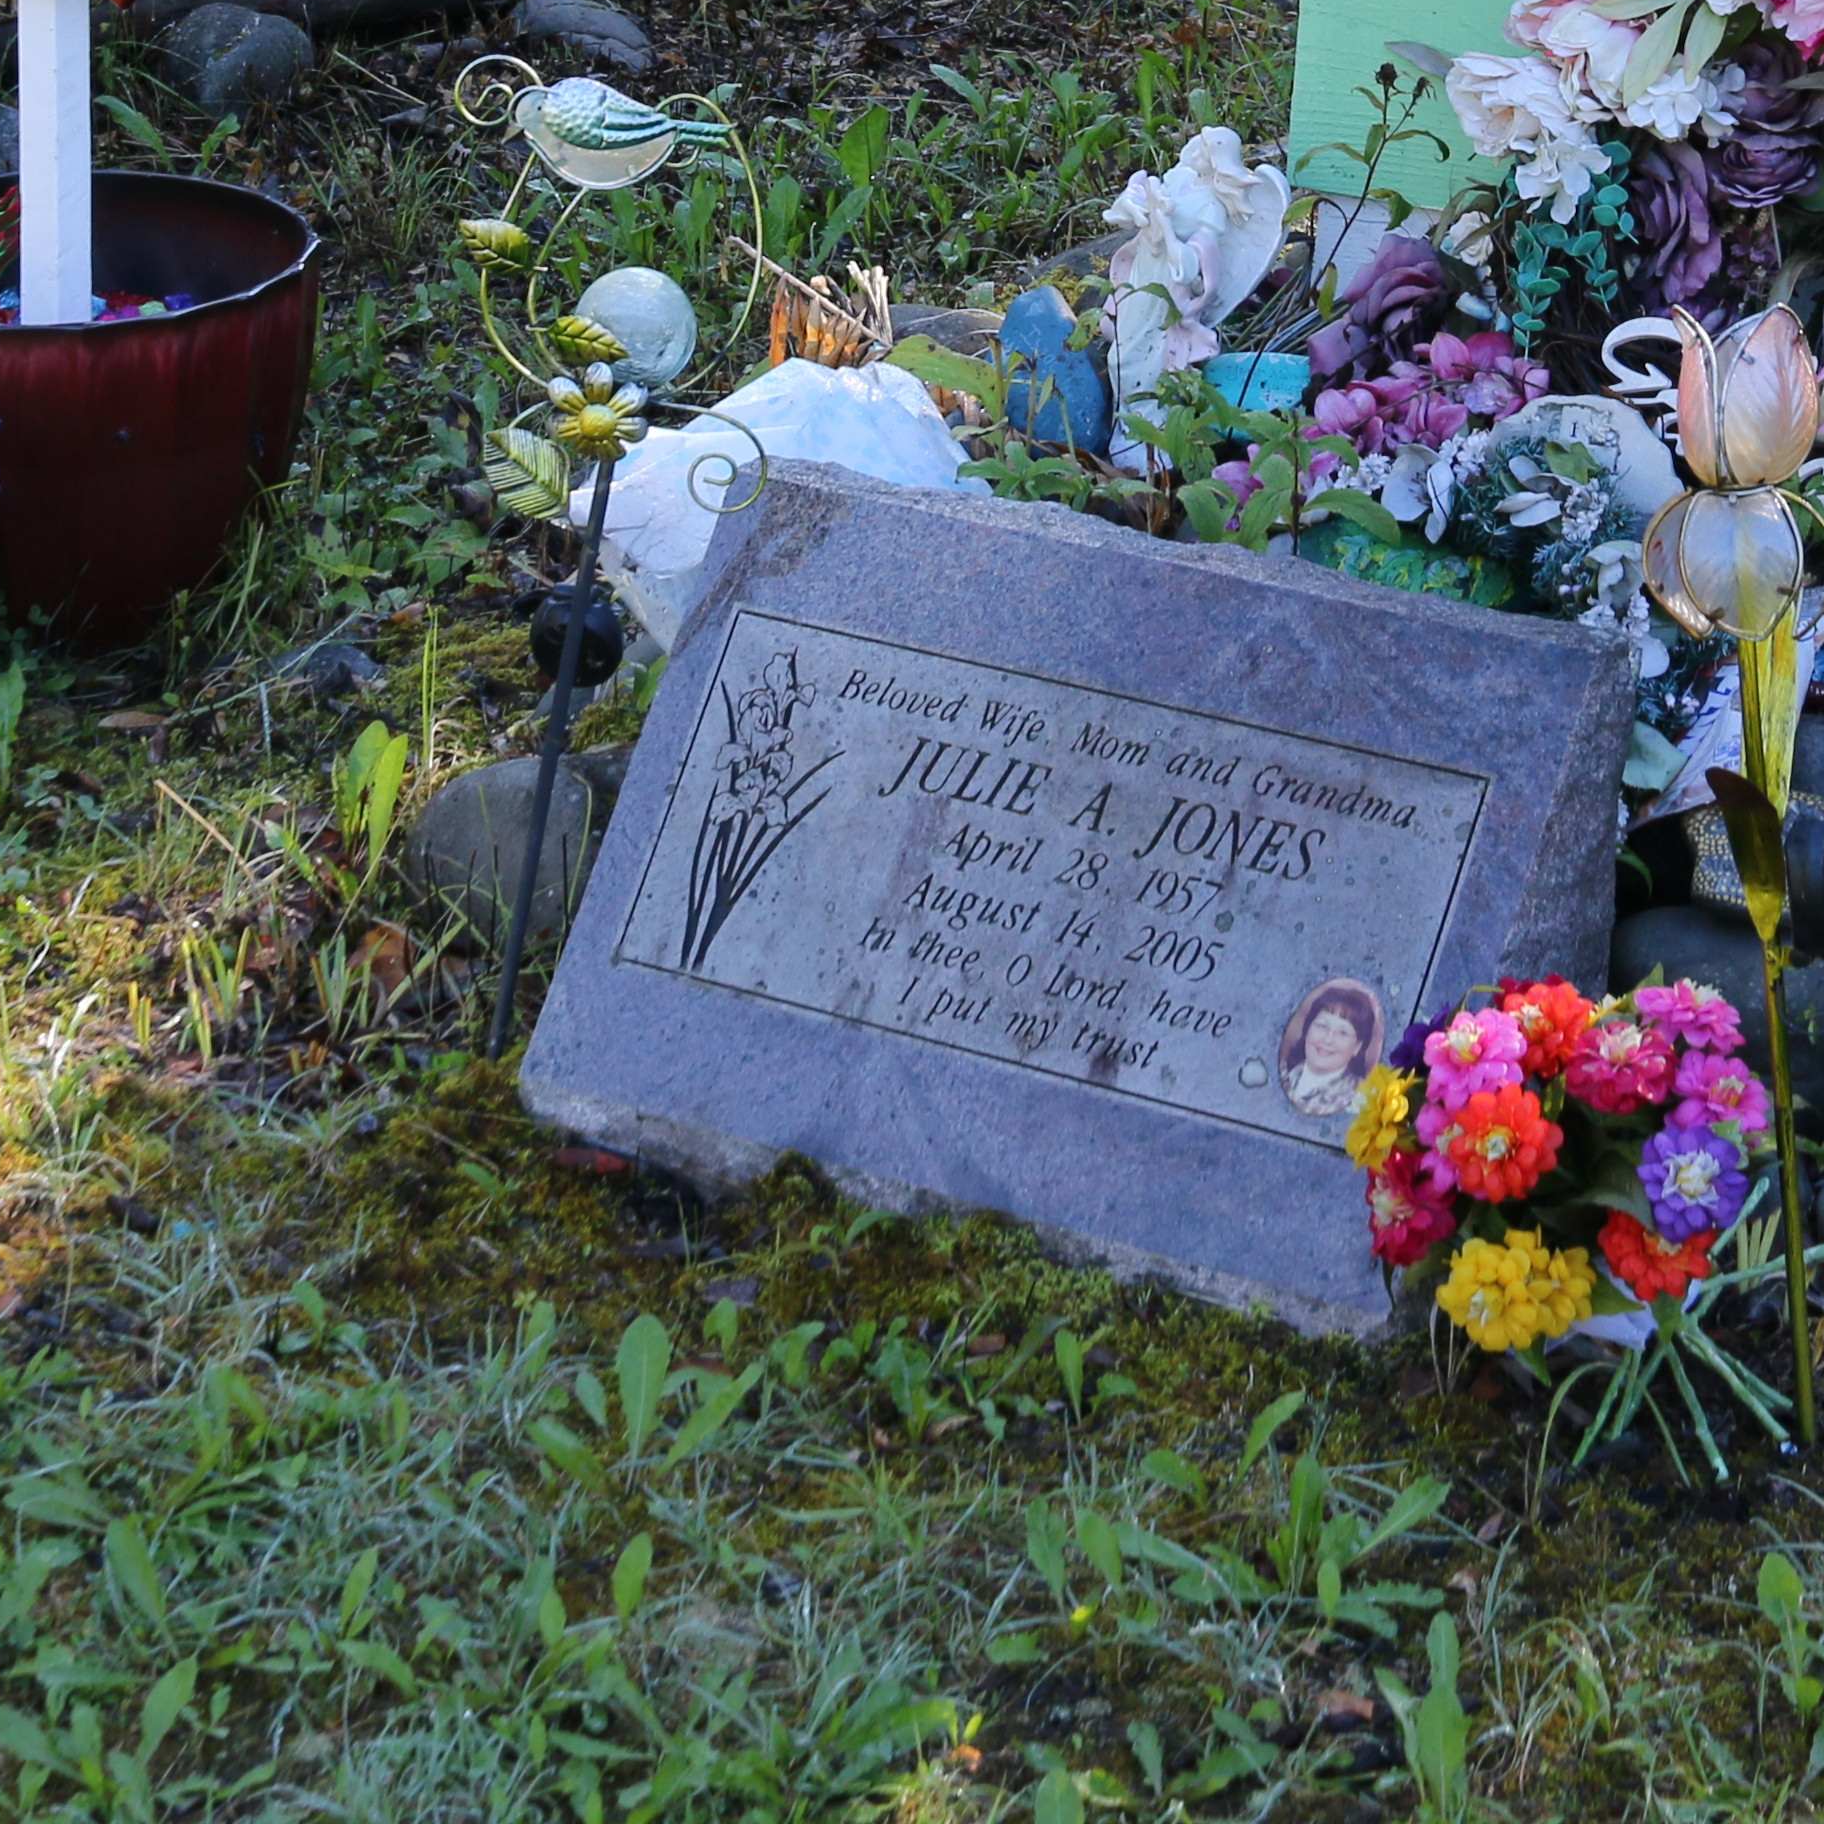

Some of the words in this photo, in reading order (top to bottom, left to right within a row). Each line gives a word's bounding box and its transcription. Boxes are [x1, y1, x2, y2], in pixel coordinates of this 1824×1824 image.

[838, 669, 967, 723] Beloved
[1071, 722, 1150, 767] Mom
[1166, 752, 1241, 786] and
[1253, 766, 1417, 828] Grandma
[878, 736, 1053, 815] JULIE
[1069, 782, 1115, 836] A.
[1132, 796, 1326, 880] JONES
[902, 873, 1041, 932] August
[1124, 925, 1225, 982] 2005
[945, 823, 1044, 874] April
[1135, 868, 1224, 919] 1957
[857, 916, 896, 953] In
[1006, 954, 1032, 987] O
[1149, 989, 1233, 1038] have
[897, 976, 919, 1005] I
[925, 986, 992, 1026] put
[1004, 1010, 1059, 1050] my
[1071, 1020, 1159, 1070] trust
